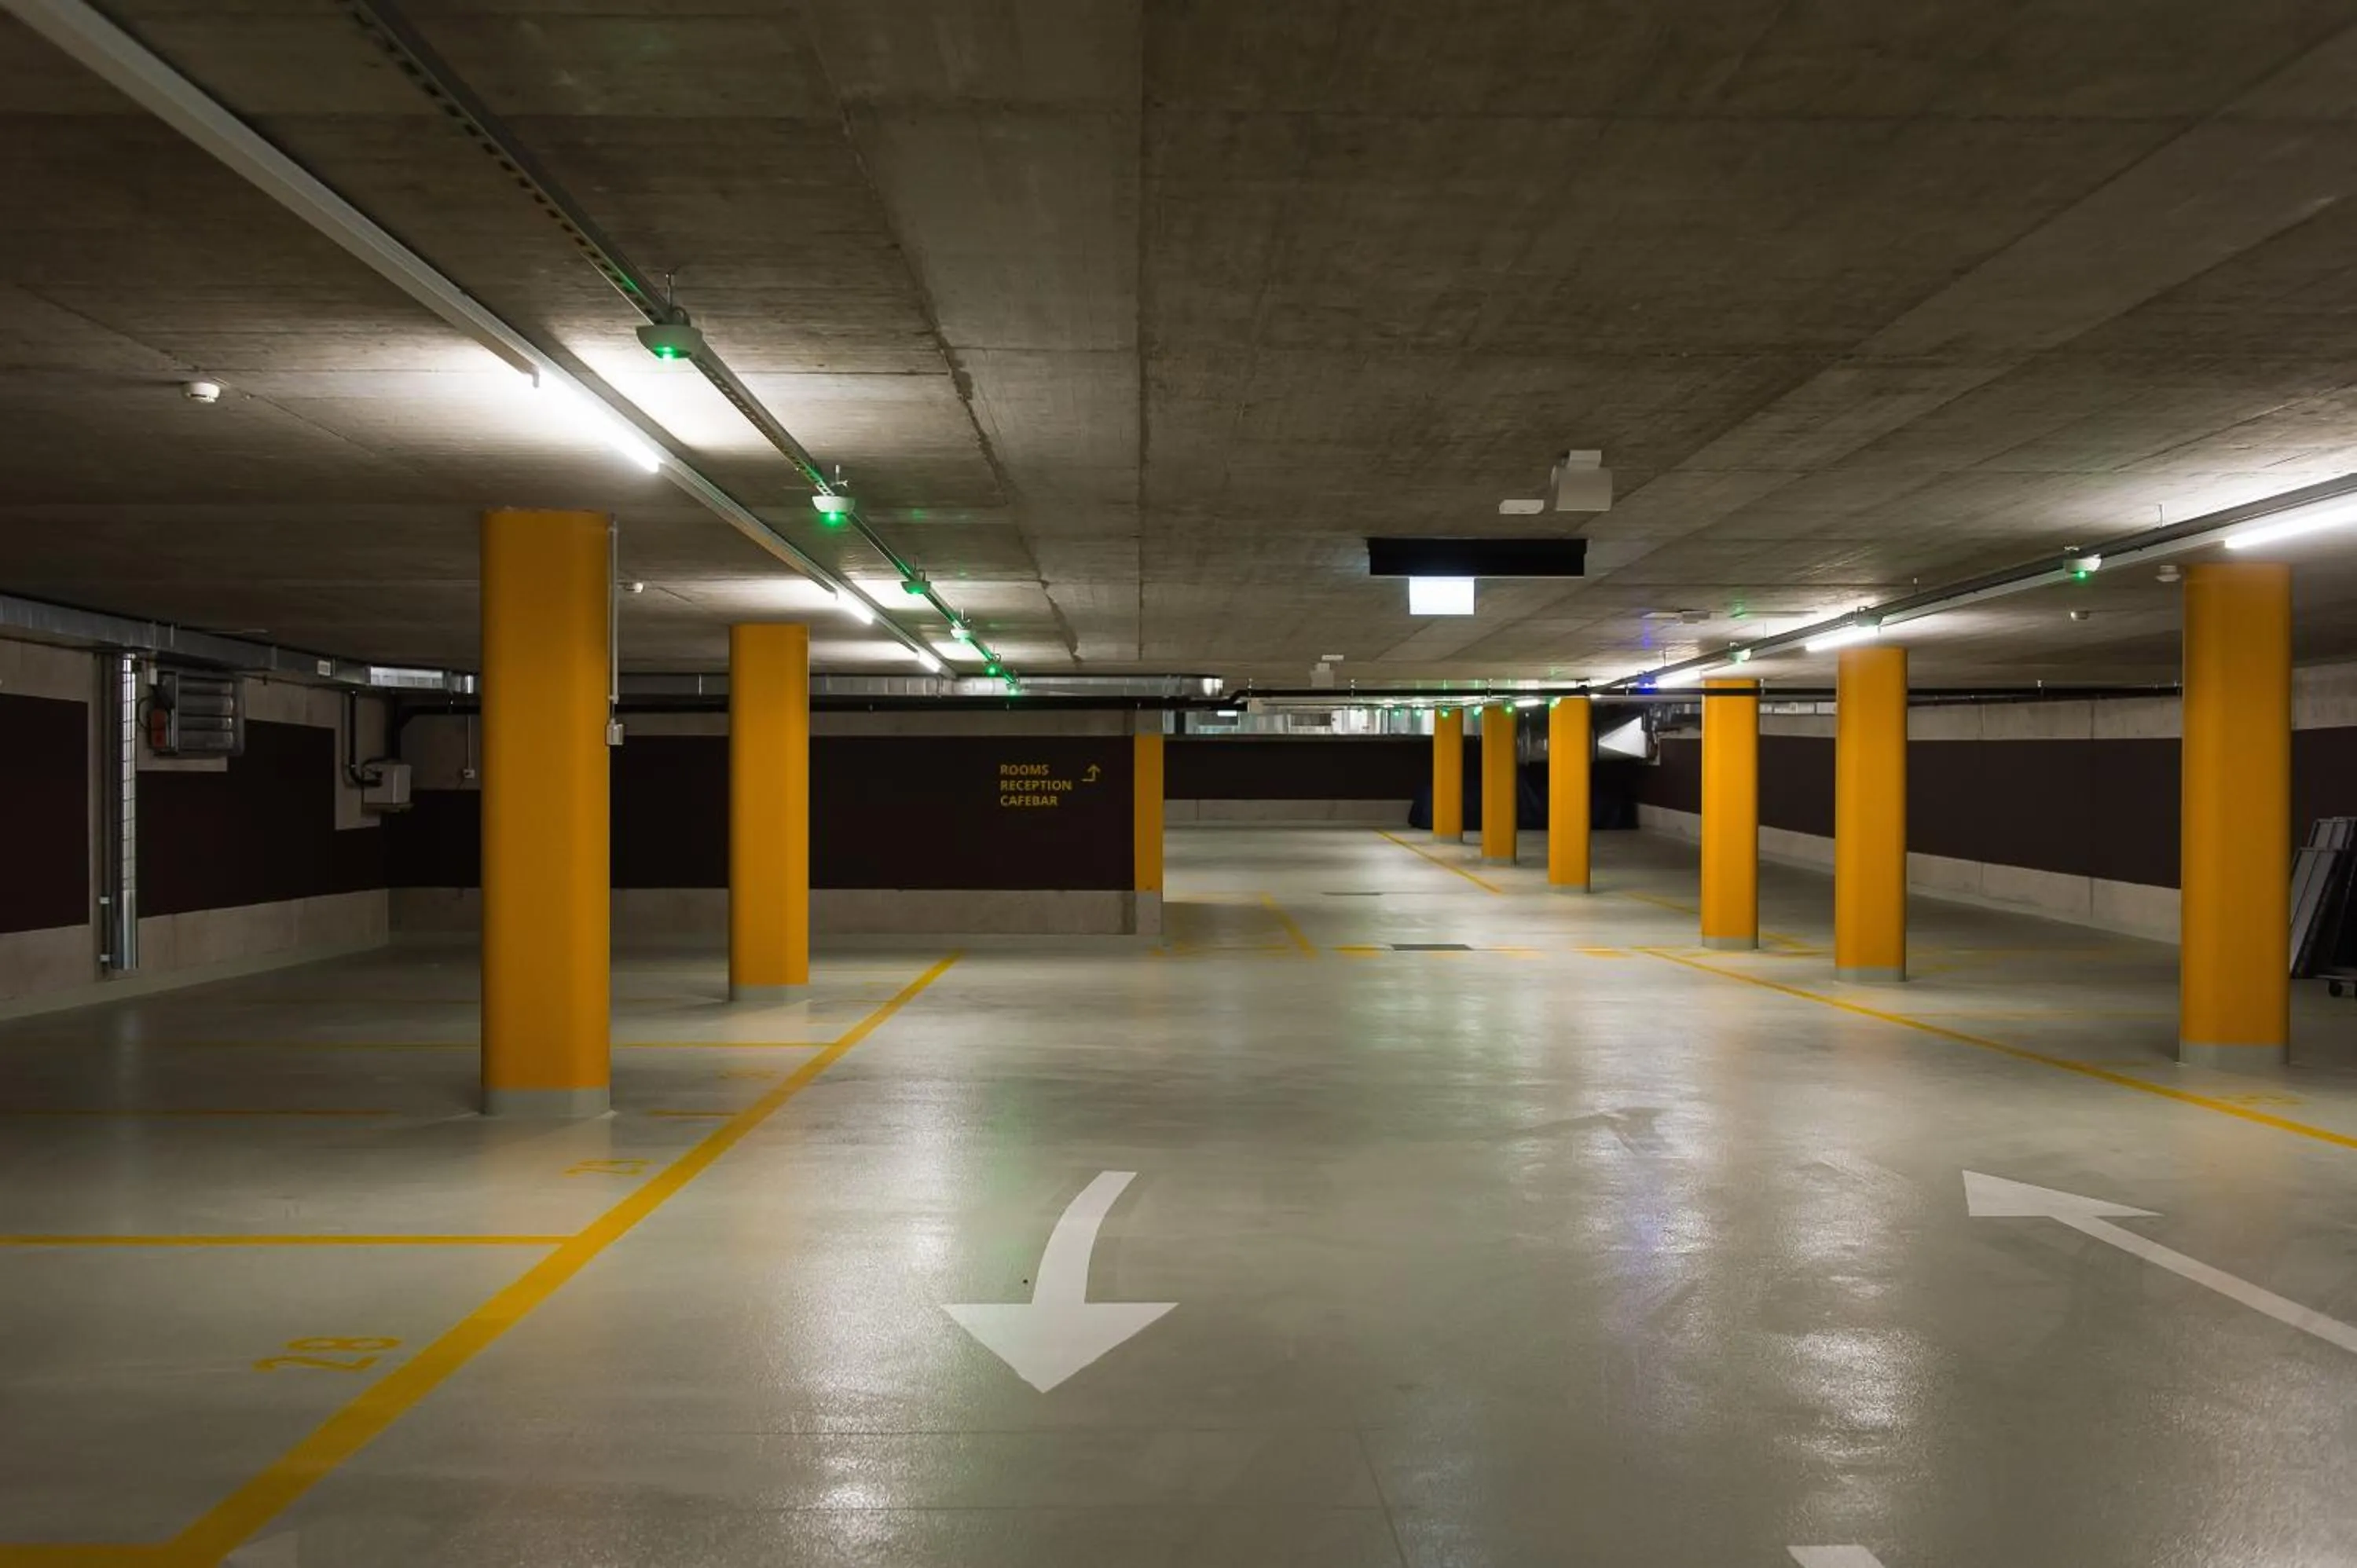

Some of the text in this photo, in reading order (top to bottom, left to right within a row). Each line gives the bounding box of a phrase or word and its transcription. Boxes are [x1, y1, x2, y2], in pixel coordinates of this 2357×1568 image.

[999, 764, 1050, 775] ROOMS
[999, 779, 1072, 791] RECEPTION
[999, 795, 1058, 807] CAFEBAR
[251, 1337, 401, 1372] 28
